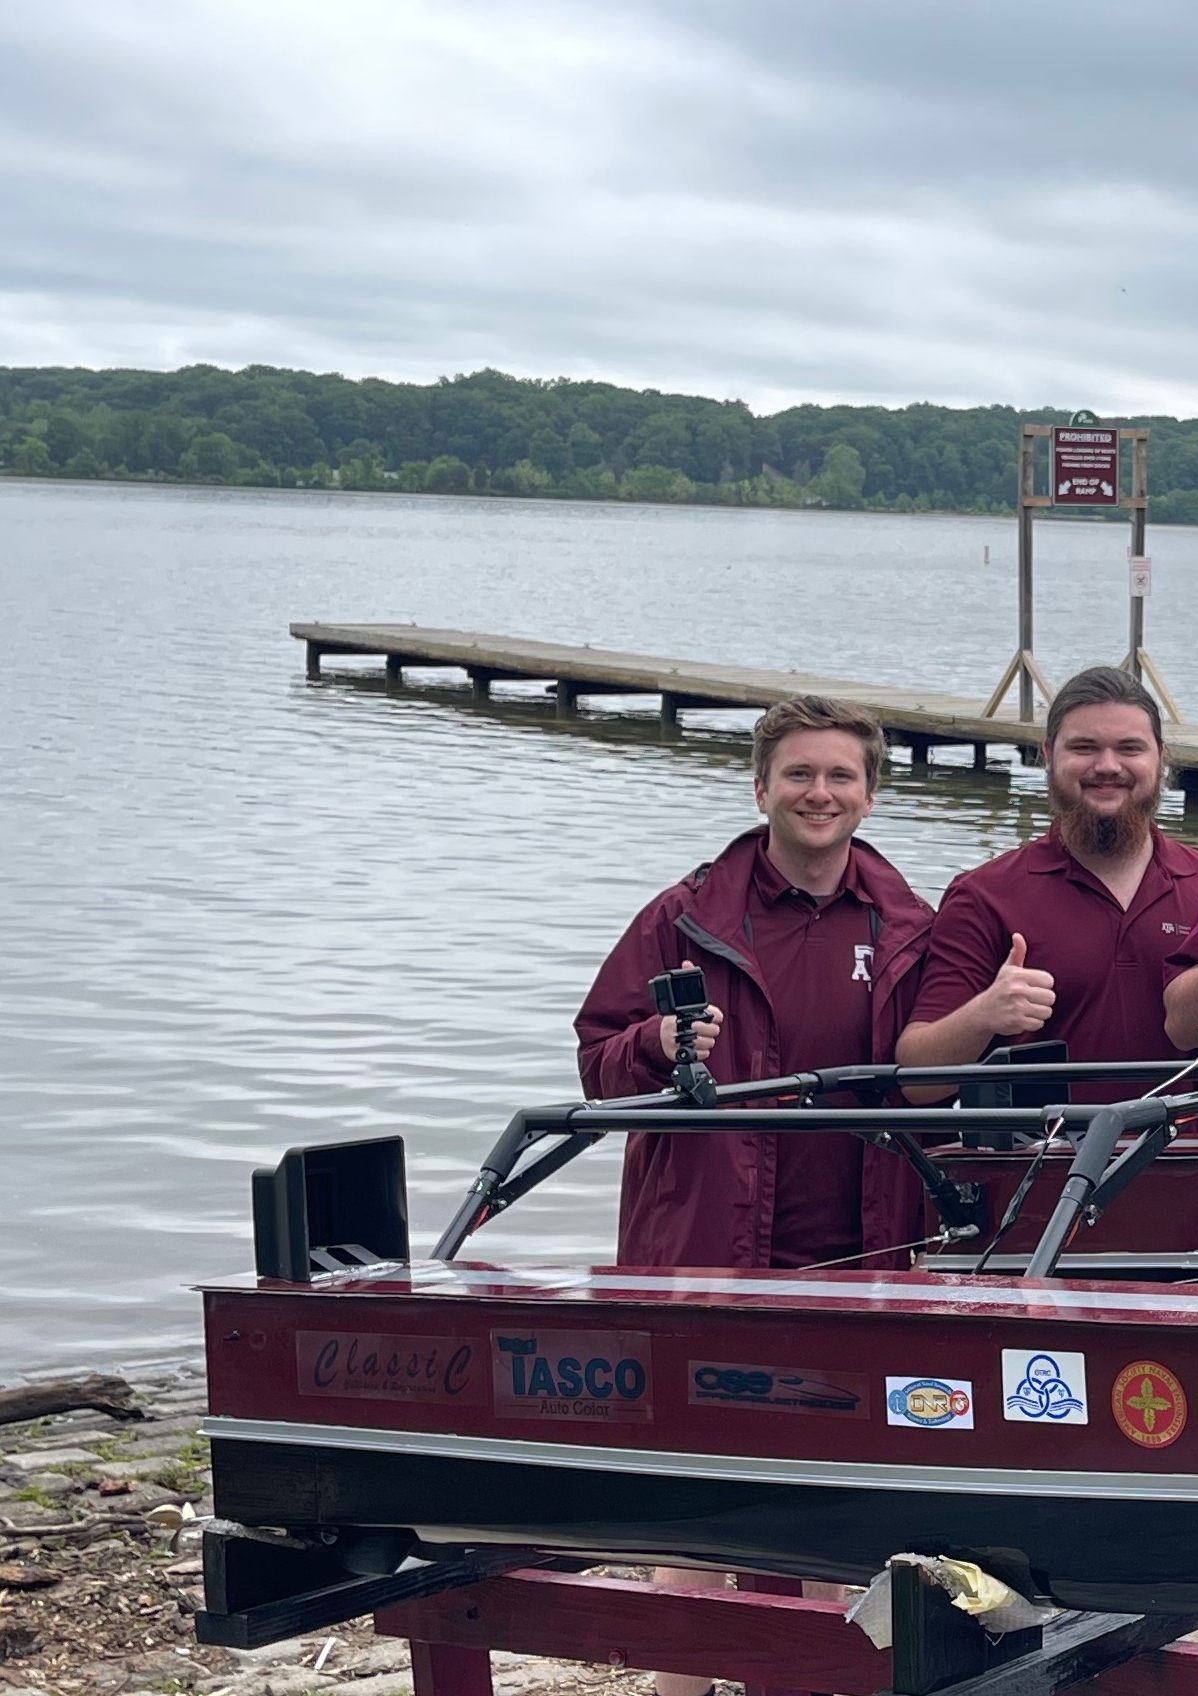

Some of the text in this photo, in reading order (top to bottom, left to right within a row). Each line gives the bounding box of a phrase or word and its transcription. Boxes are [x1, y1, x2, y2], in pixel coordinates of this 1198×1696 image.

[1059, 432, 1112, 443] PROHIBITED
[497, 1335, 646, 1399] TASCO
[1121, 1366, 1146, 1389] SOCIETY
[540, 1401, 610, 1416] Auto Color
[910, 1394, 948, 1412] ONR
